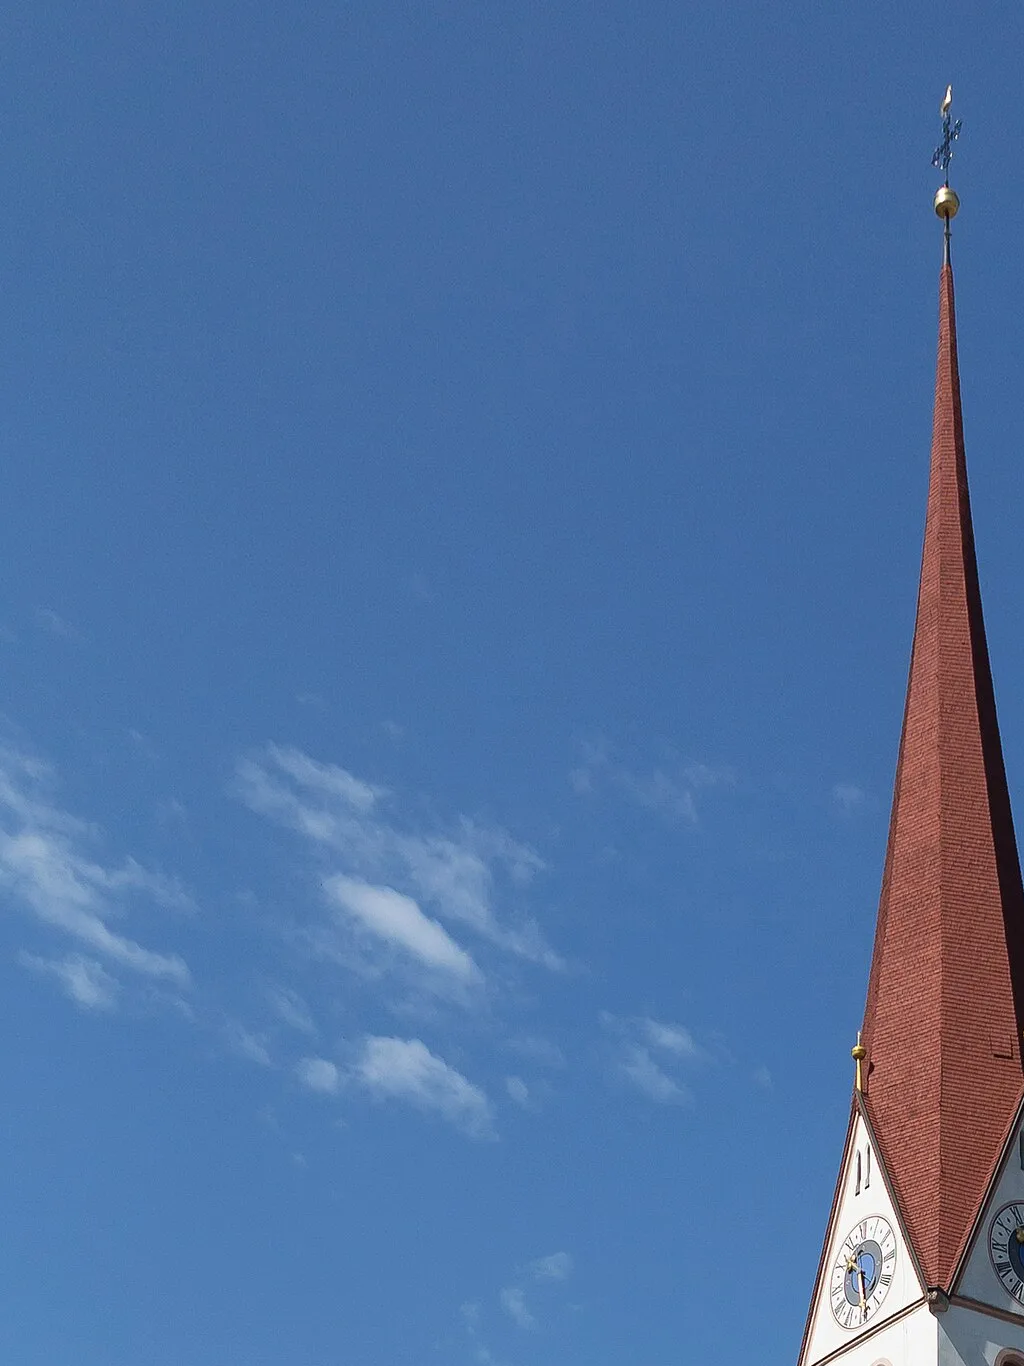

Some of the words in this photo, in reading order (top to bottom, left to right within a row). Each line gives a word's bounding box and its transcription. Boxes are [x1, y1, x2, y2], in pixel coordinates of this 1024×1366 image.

[1010, 1206, 1024, 1225] XI
[996, 1219, 1012, 1237] X
[995, 1261, 1013, 1279] VIII
[1010, 1280, 1024, 1300] VII
